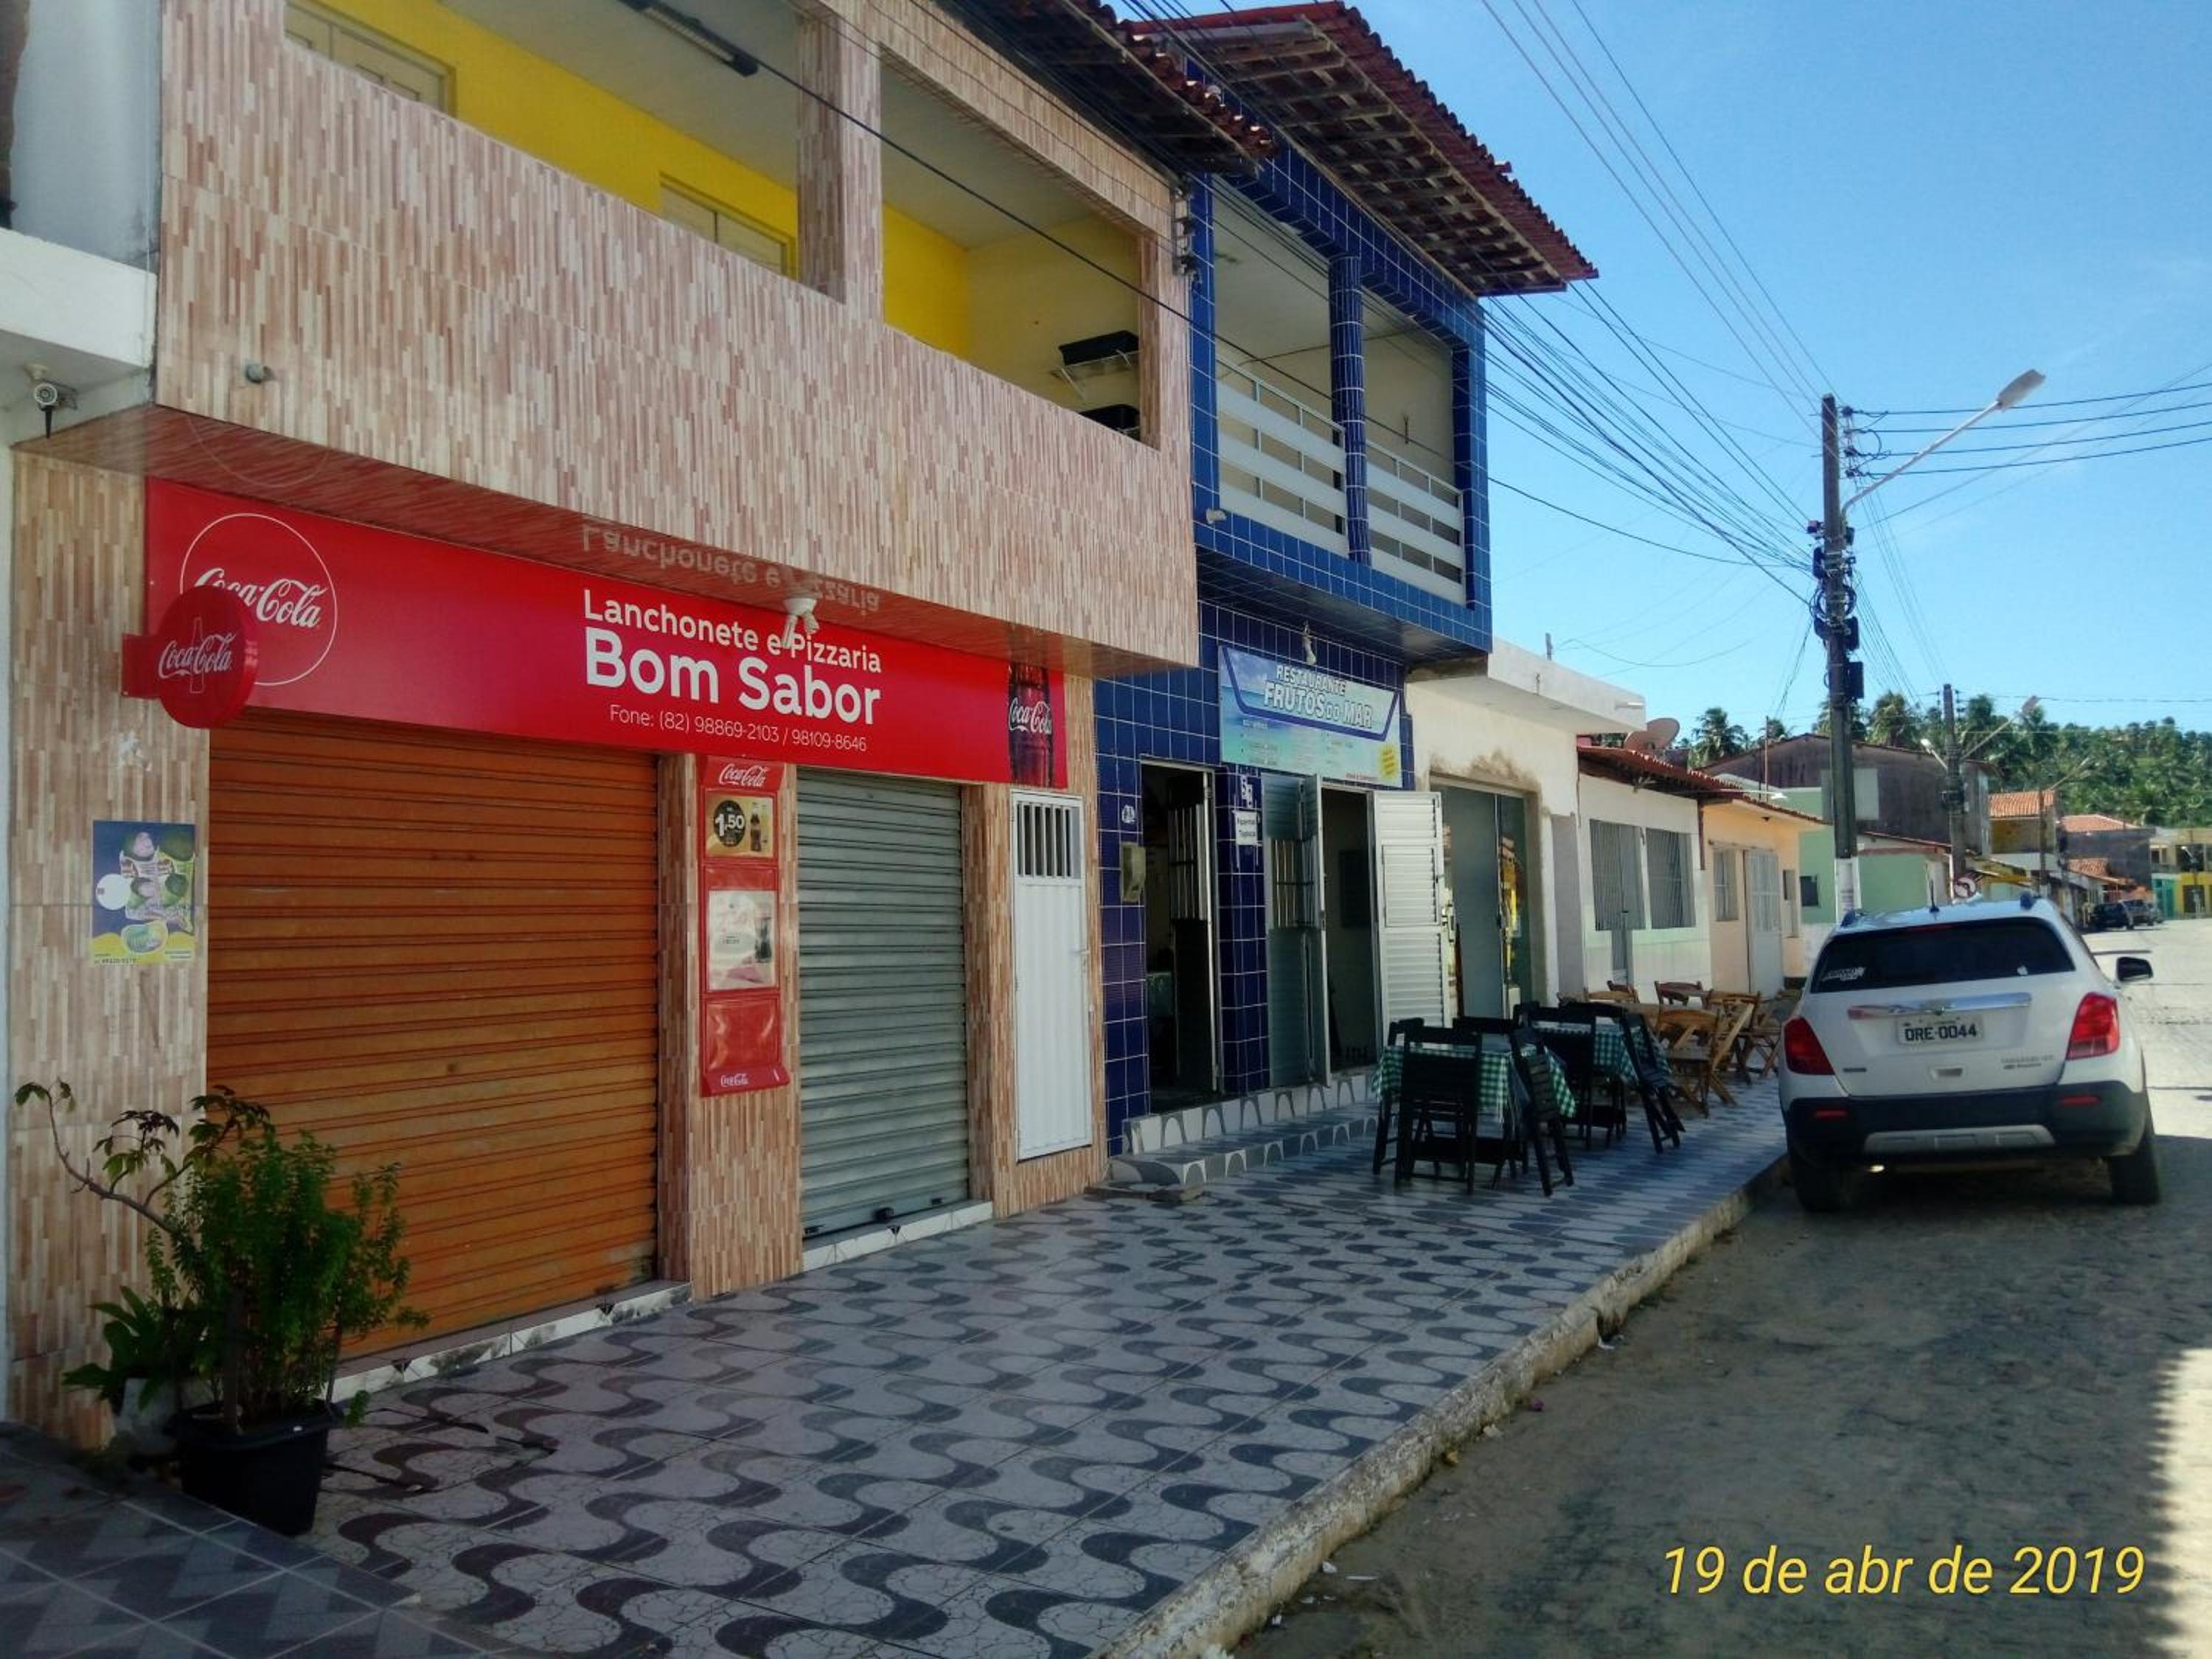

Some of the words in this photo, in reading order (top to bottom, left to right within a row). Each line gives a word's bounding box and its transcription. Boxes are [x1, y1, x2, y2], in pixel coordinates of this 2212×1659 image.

[584, 589, 759, 650] Lanchonete
[767, 632, 782, 655] e
[790, 630, 883, 672] Pizzaria
[585, 626, 720, 704] Bom
[738, 656, 881, 725] Sabor
[1276, 664, 1346, 696] RESTAURANTE
[608, 703, 655, 728] Fone:
[659, 711, 690, 734] (82)
[694, 715, 779, 743] 98869-2103
[791, 728, 867, 751] 98109-8646
[1263, 681, 1326, 718] FRUTOS
[1343, 700, 1372, 728] MAR
